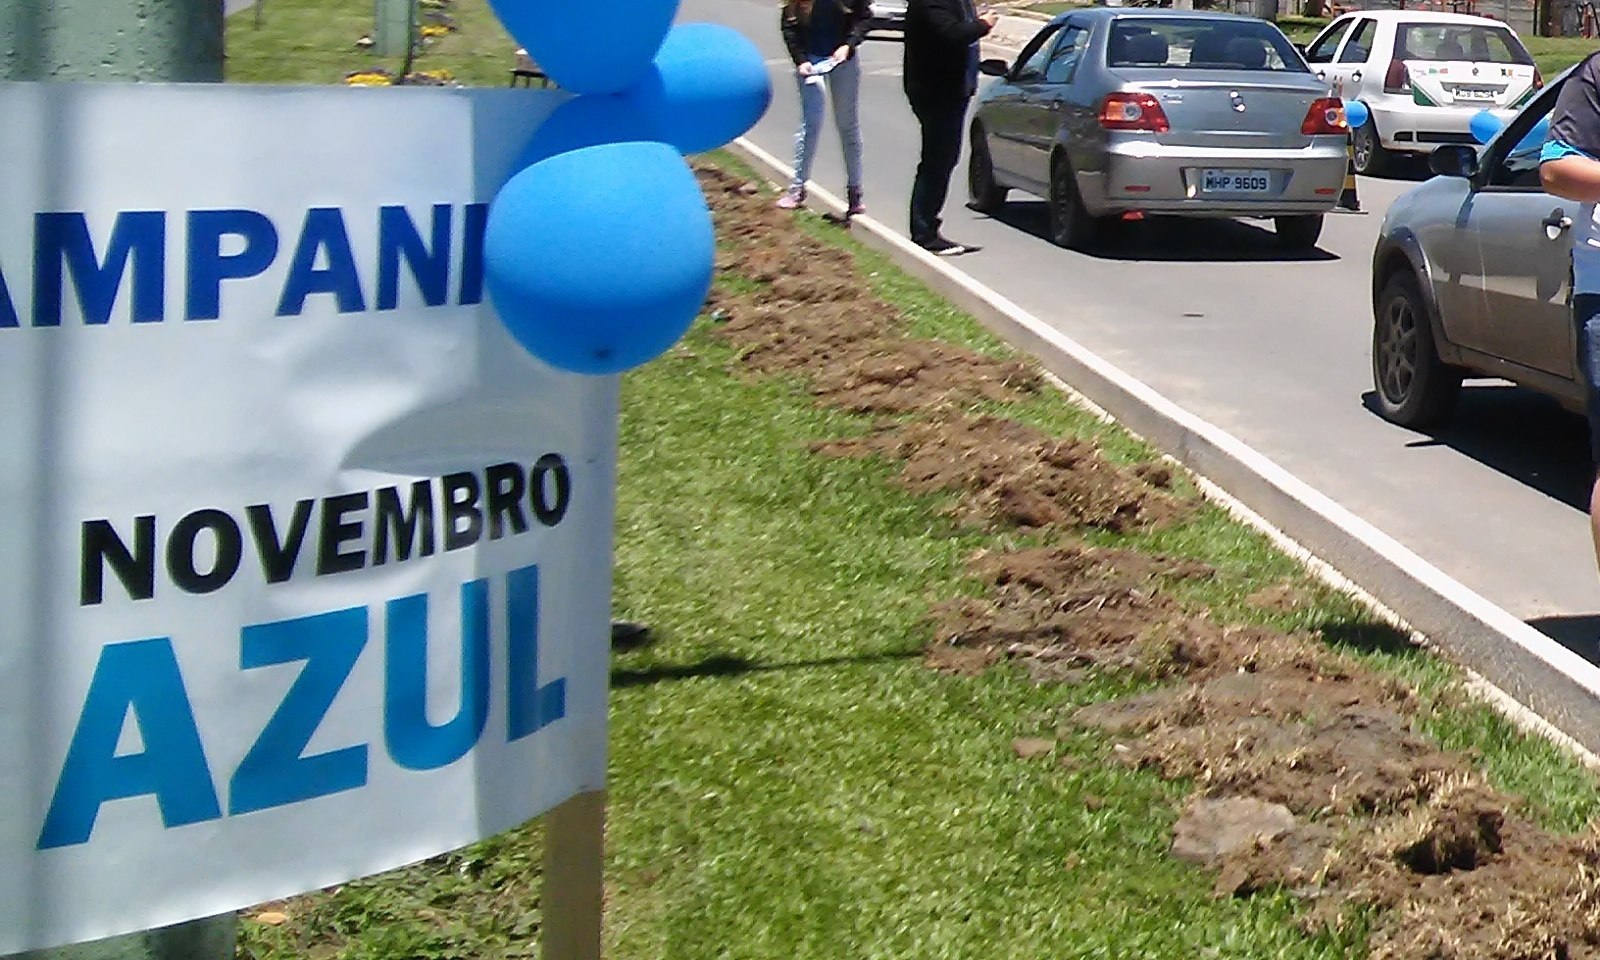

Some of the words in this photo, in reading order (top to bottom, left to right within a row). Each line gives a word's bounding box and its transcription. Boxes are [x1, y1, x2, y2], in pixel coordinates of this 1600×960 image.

[0, 202, 488, 329] MPAN
[79, 452, 571, 607] NOVEMBRO
[36, 564, 568, 851] AZUL
